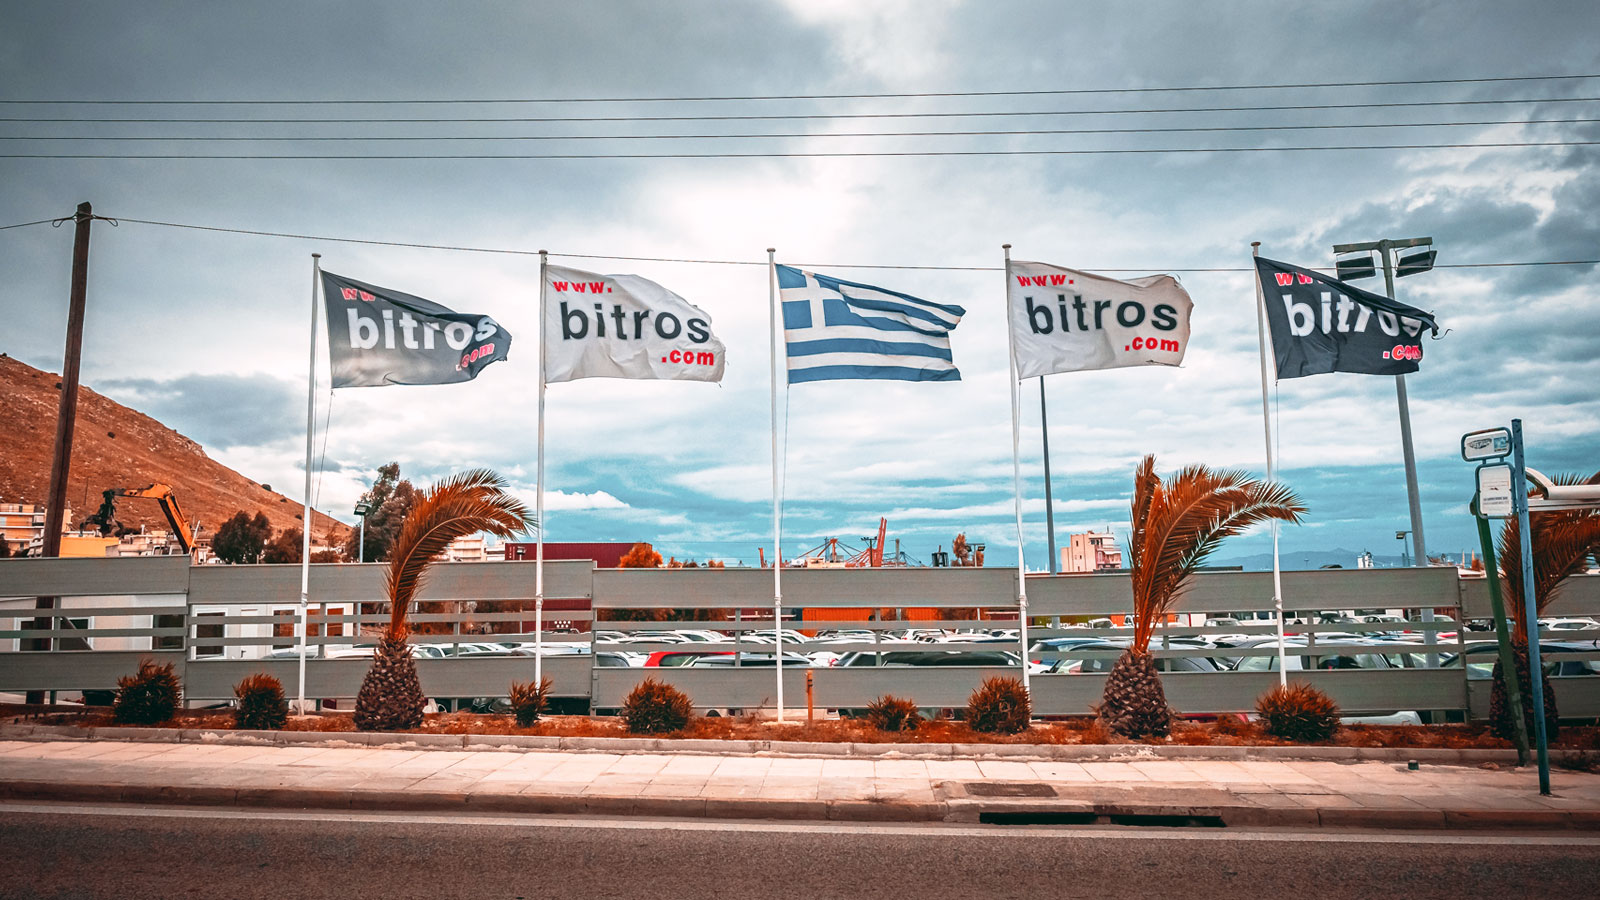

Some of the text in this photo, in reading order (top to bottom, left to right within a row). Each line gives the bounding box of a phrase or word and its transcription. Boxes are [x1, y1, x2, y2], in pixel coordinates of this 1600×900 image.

[552, 281, 612, 294] www.
[1017, 274, 1074, 287] www.
[560, 301, 711, 344] bitros
[1025, 294, 1178, 335] bitros
[1282, 291, 1422, 337] bitros
[346, 308, 498, 350] bitros
[455, 342, 495, 371] .com
[661, 350, 715, 366] .com
[1124, 336, 1179, 353] .com
